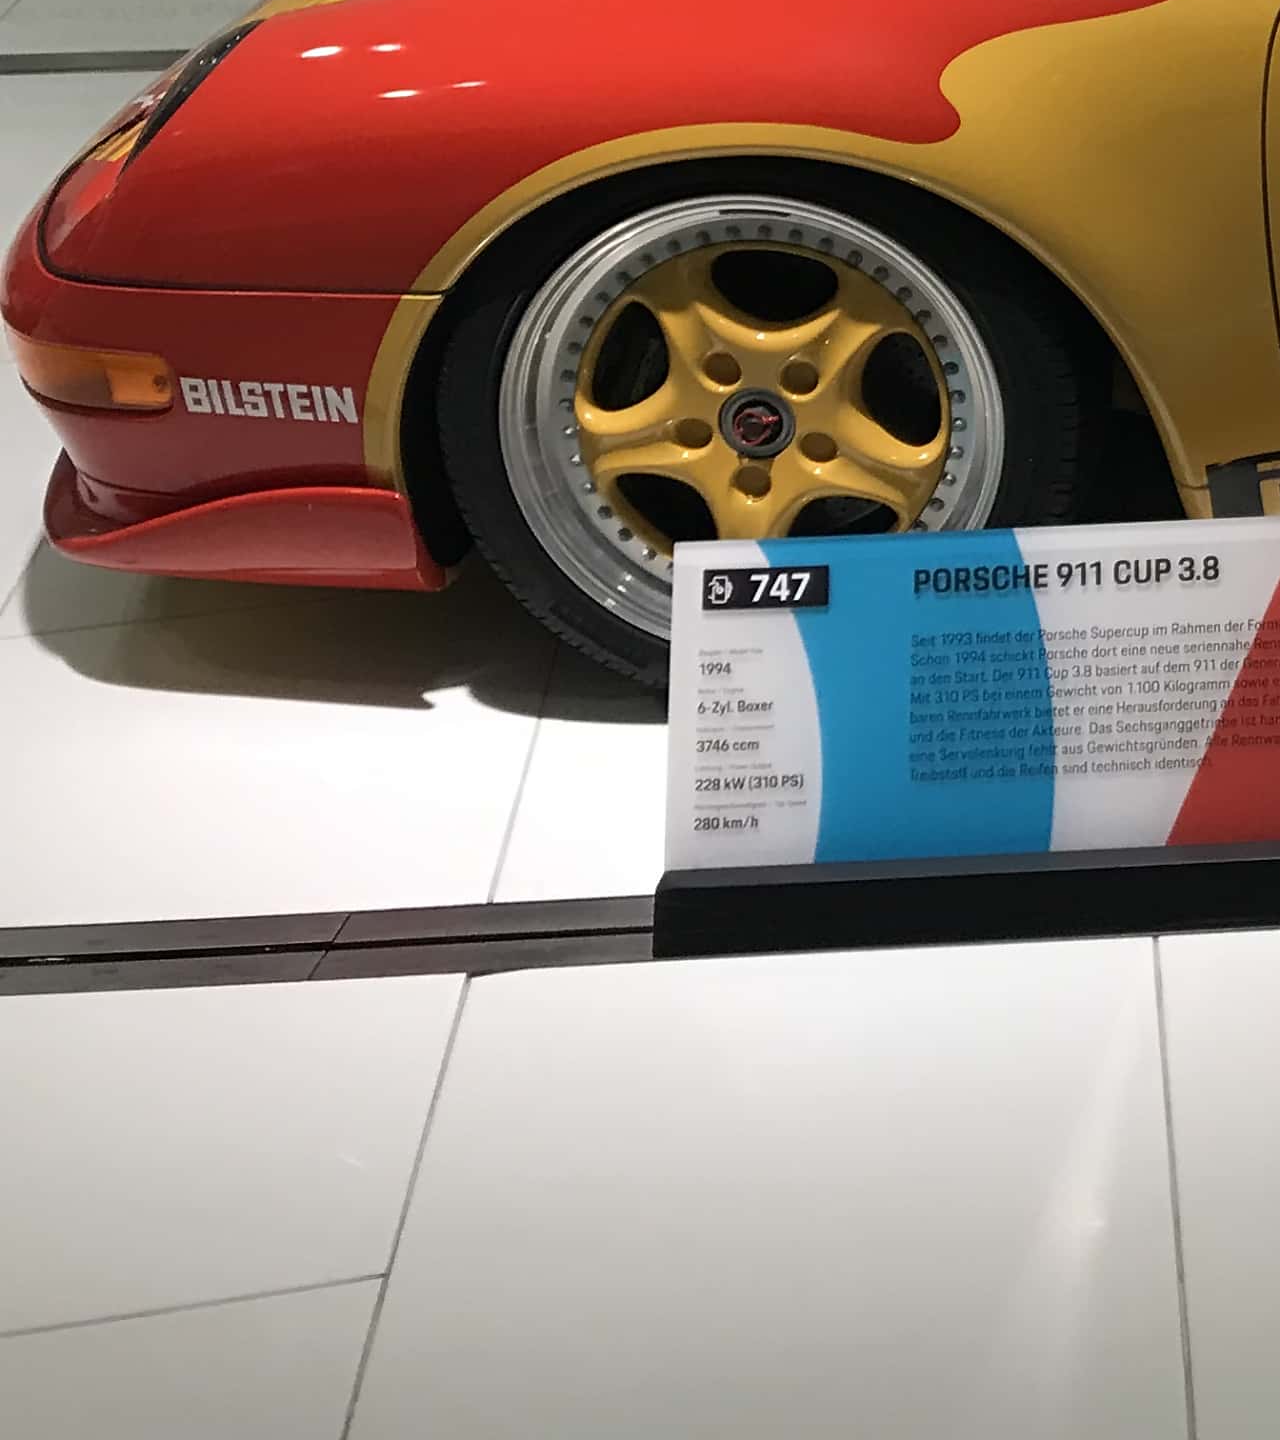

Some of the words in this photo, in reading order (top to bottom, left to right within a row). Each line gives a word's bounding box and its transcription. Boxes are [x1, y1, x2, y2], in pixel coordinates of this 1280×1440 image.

[178, 375, 360, 424] BILSTEIN
[913, 564, 1049, 595] PORSCHE
[1056, 561, 1101, 588] 911
[1113, 558, 1171, 585] CUP
[1178, 555, 1220, 582] 3.8
[749, 571, 811, 604] 747
[699, 663, 732, 676] 1994
[737, 701, 773, 713] Boxer
[696, 739, 730, 753] 3746
[733, 741, 760, 751] ccm
[695, 779, 721, 792] 228
[723, 777, 745, 790] kW
[748, 775, 779, 790] (310
[781, 774, 804, 789] PS)
[694, 817, 720, 831] 280
[723, 816, 759, 830] km/h
